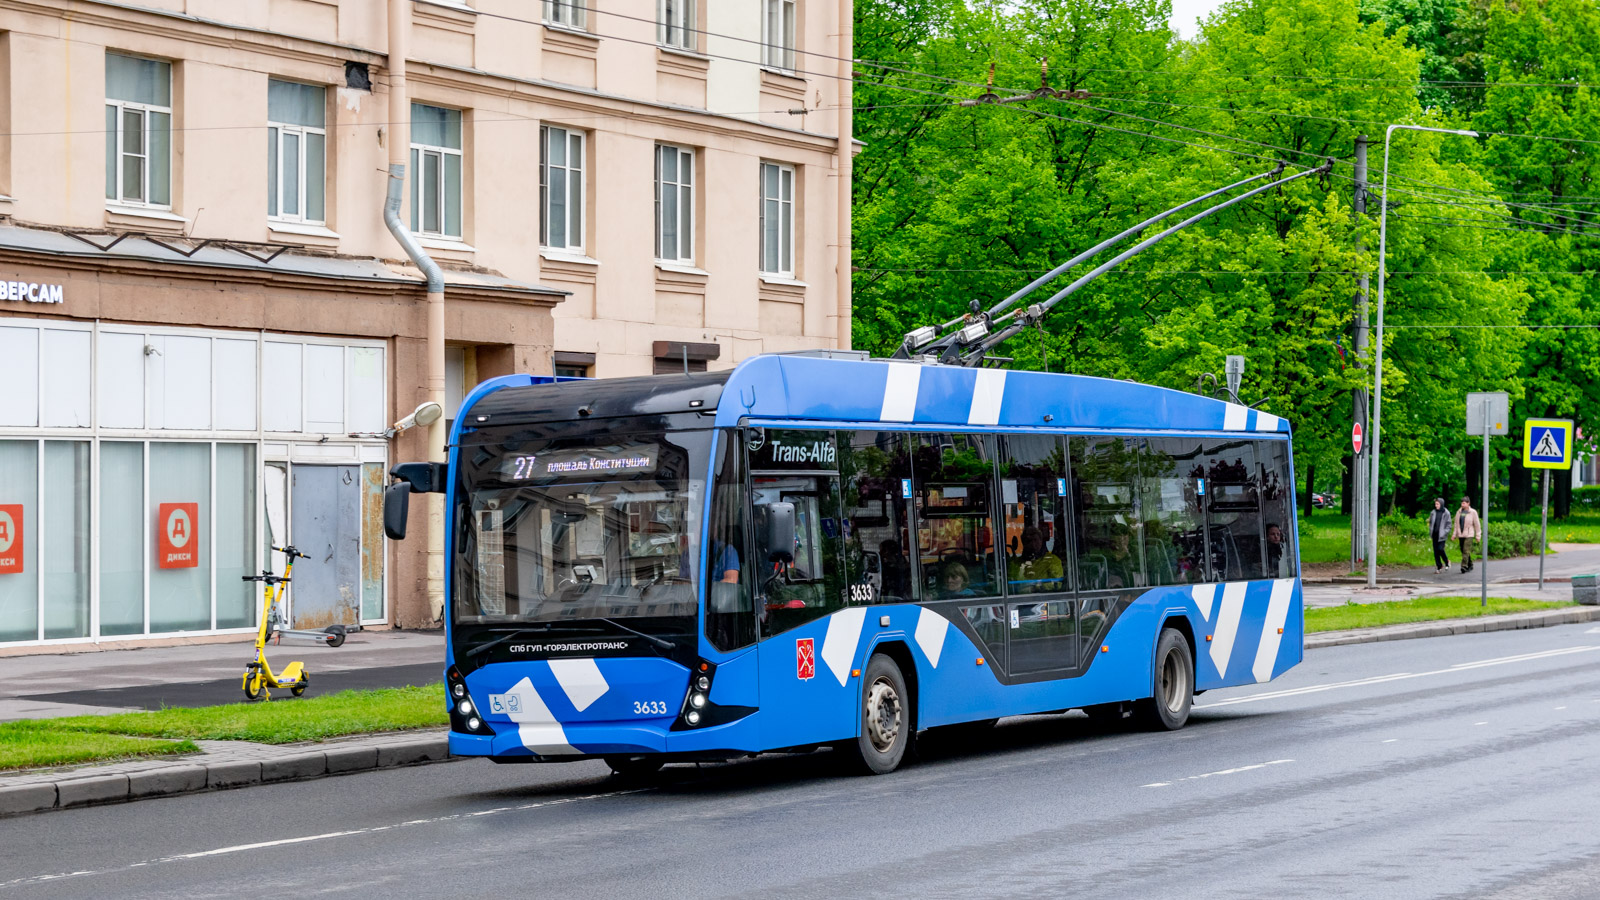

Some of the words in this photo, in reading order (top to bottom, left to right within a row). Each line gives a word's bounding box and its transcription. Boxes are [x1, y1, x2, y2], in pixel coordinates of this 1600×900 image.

[0, 280, 63, 304] ВЕРСАМ
[771, 440, 836, 463] Trans-Alfa
[513, 456, 536, 479] 27
[589, 457, 650, 471] Конституции
[167, 553, 191, 562] ДИКСИ
[851, 584, 872, 601] 3633
[509, 644, 525, 653] СПб
[526, 644, 542, 653] ГУП
[543, 641, 628, 652] «ГОРЭЛЕКТРОТРАНС»
[633, 701, 667, 715] 3633
